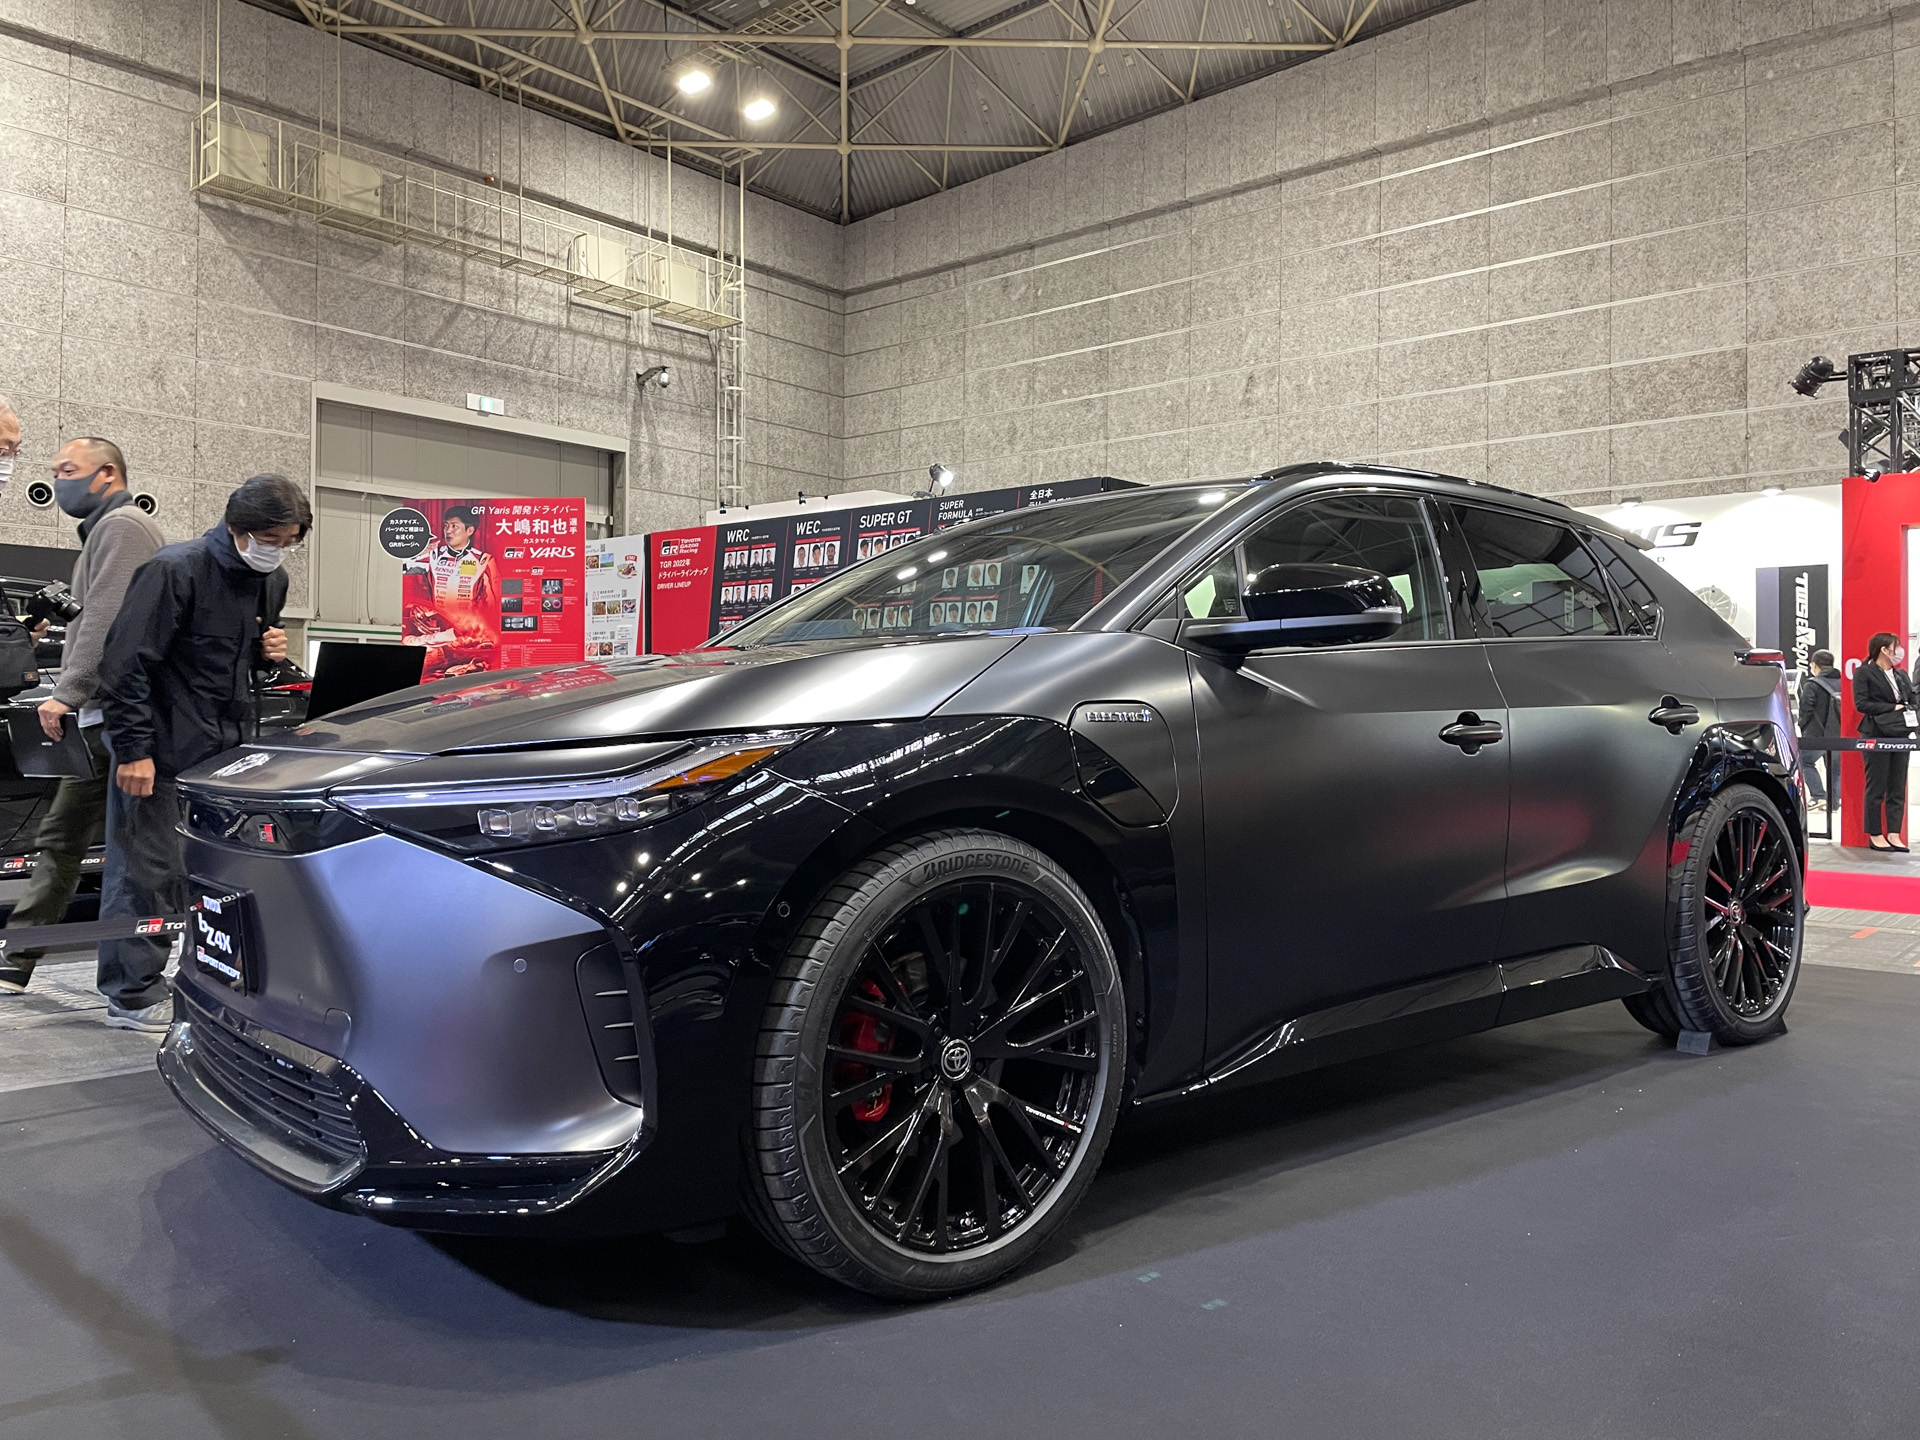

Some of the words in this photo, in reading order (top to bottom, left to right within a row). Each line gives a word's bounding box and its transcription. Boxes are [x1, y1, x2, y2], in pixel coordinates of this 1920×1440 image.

[1029, 488, 1054, 500] 全日本
[471, 506, 486, 515] GR
[488, 506, 511, 515] Yaris
[512, 505, 579, 515] 開発ドライバー
[939, 500, 965, 511] SUPER
[859, 512, 896, 529] SUPER
[897, 509, 913, 525] GT
[938, 508, 973, 521] FORMULA
[495, 517, 568, 536] 大嶋和也
[796, 520, 821, 536] WEC
[523, 537, 556, 545] カスタマイズ
[727, 528, 750, 544] WRC
[660, 560, 673, 569] TGR
[673, 558, 691, 568] 2022年
[658, 566, 709, 580] ドライバーラインナップ
[656, 582, 674, 590] DRIVER
[673, 581, 692, 589] LINEUP
[923, 853, 1030, 881] BRIDGESTONE
